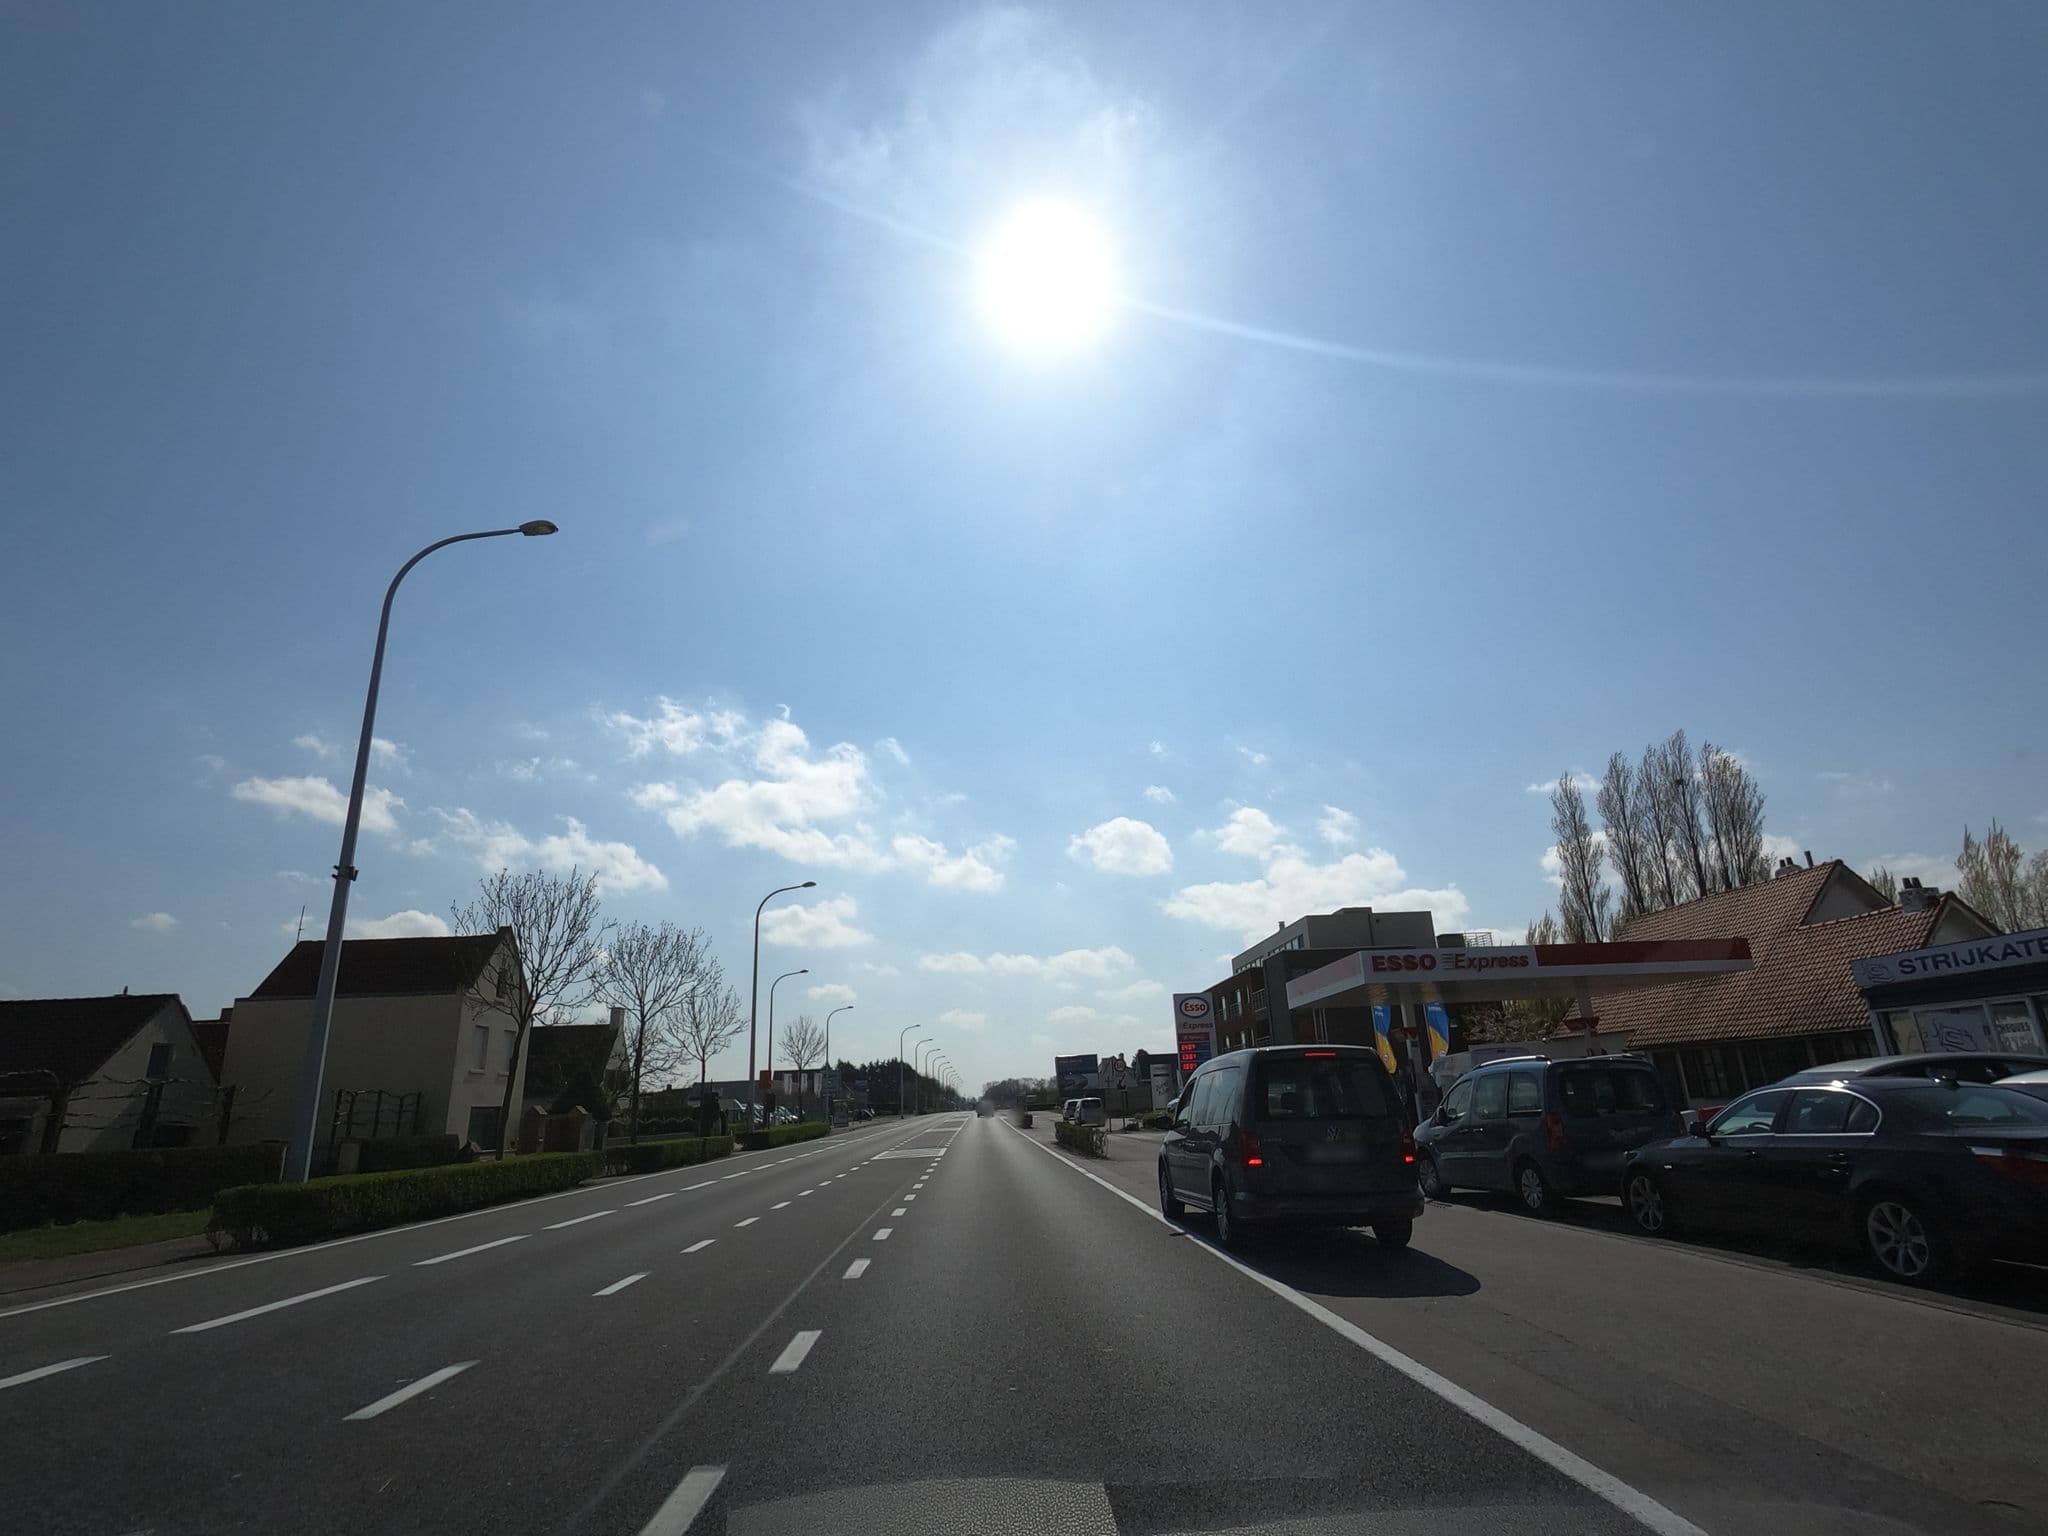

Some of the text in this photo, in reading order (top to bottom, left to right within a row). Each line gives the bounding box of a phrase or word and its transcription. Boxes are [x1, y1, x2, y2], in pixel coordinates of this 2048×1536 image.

[1371, 953, 1529, 972] ESSO Express
[1184, 1003, 1206, 1012] Esso
[1183, 1022, 1213, 1030] Express
